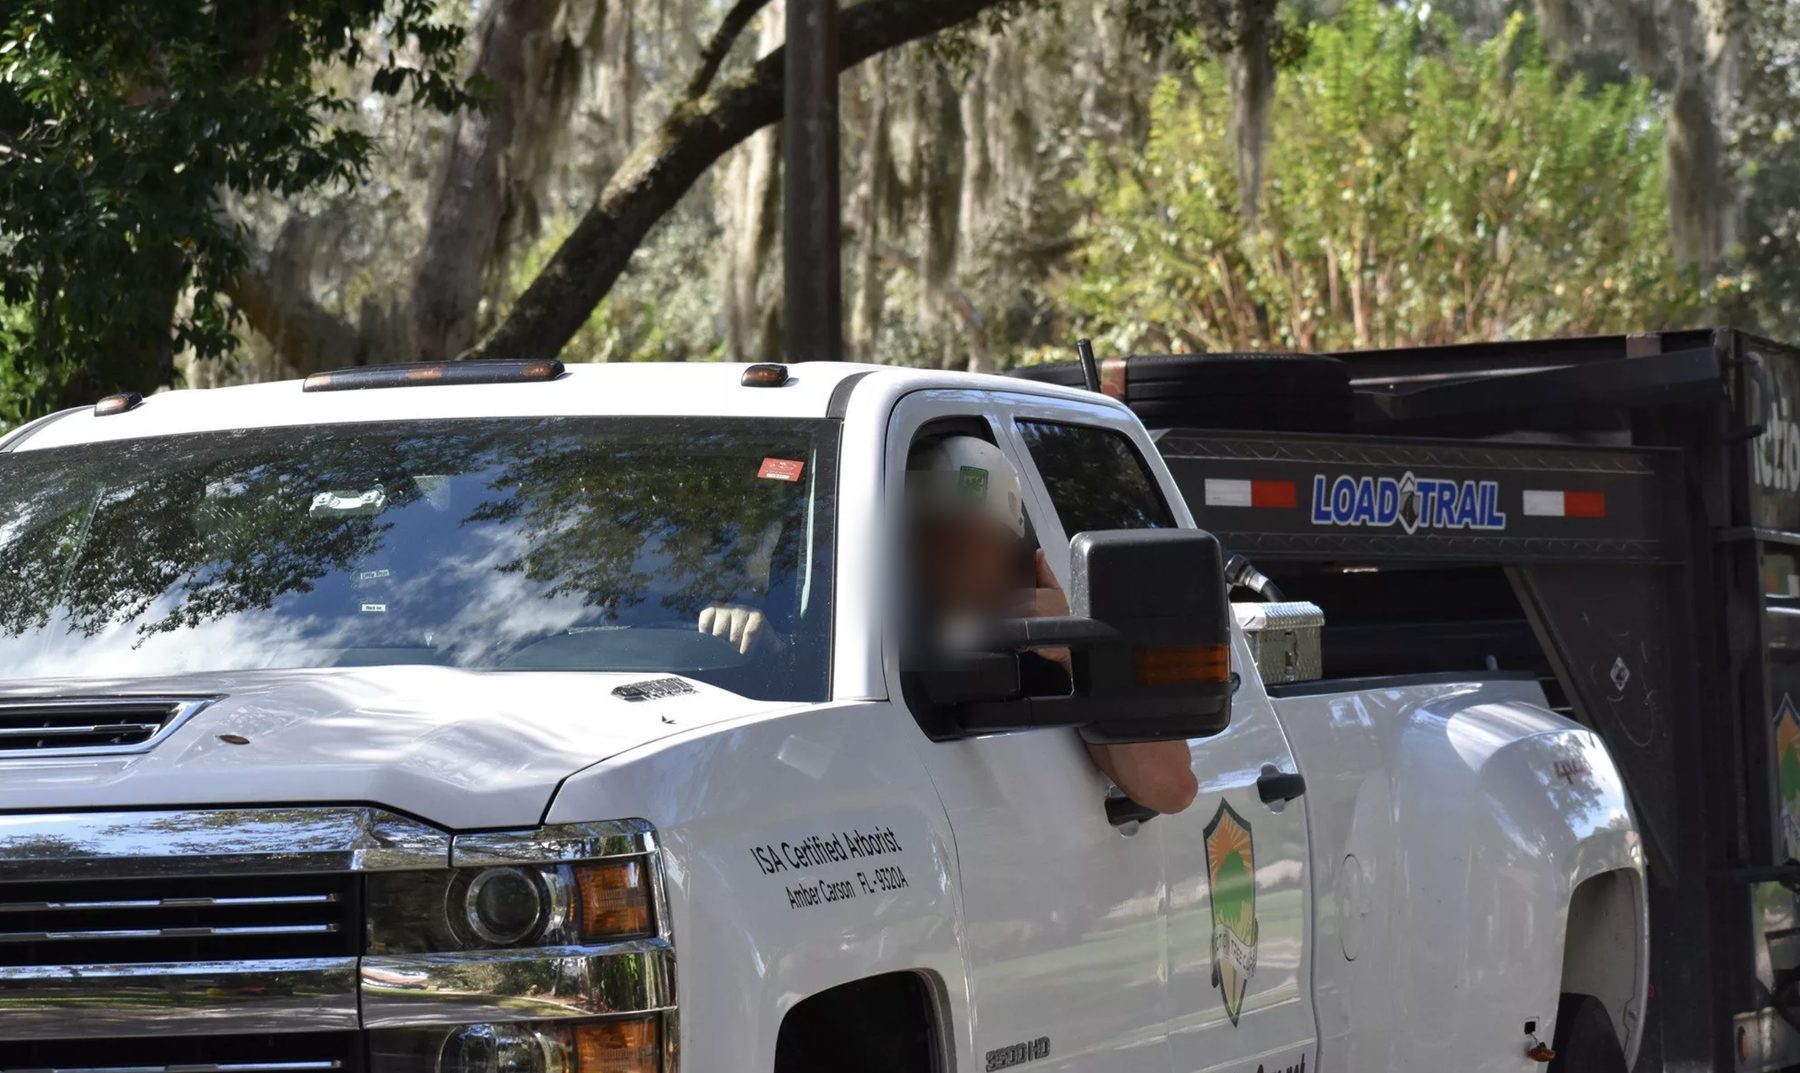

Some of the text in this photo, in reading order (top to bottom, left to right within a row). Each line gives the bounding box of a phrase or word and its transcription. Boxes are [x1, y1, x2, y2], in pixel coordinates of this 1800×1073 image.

[1311, 474, 1506, 530] LOAD TRAIL
[750, 825, 903, 875] ISA Certified Arborist
[785, 883, 823, 910] Amber
[818, 879, 857, 903] Carson
[1027, 1036, 1051, 1062] HD
